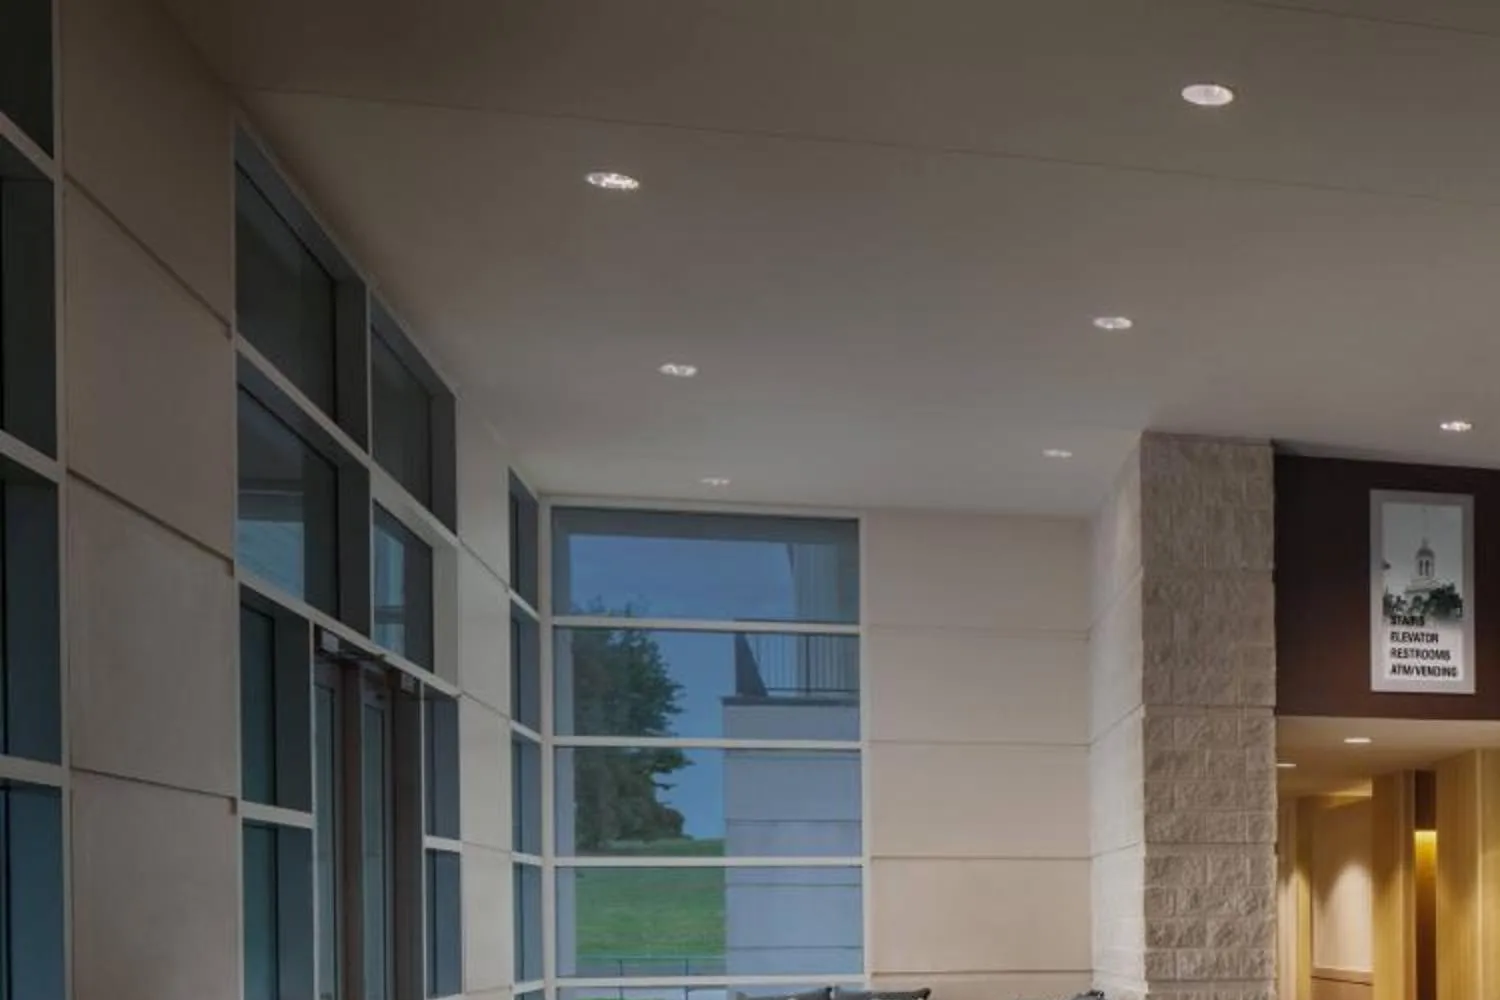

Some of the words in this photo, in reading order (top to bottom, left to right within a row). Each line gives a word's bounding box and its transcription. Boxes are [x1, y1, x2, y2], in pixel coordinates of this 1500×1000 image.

[1390, 615, 1425, 626] STAIRS
[1390, 631, 1439, 644] ELEVATOR
[1390, 647, 1451, 661] RESTROOMS
[1391, 664, 1458, 677] ATM/VENDING
